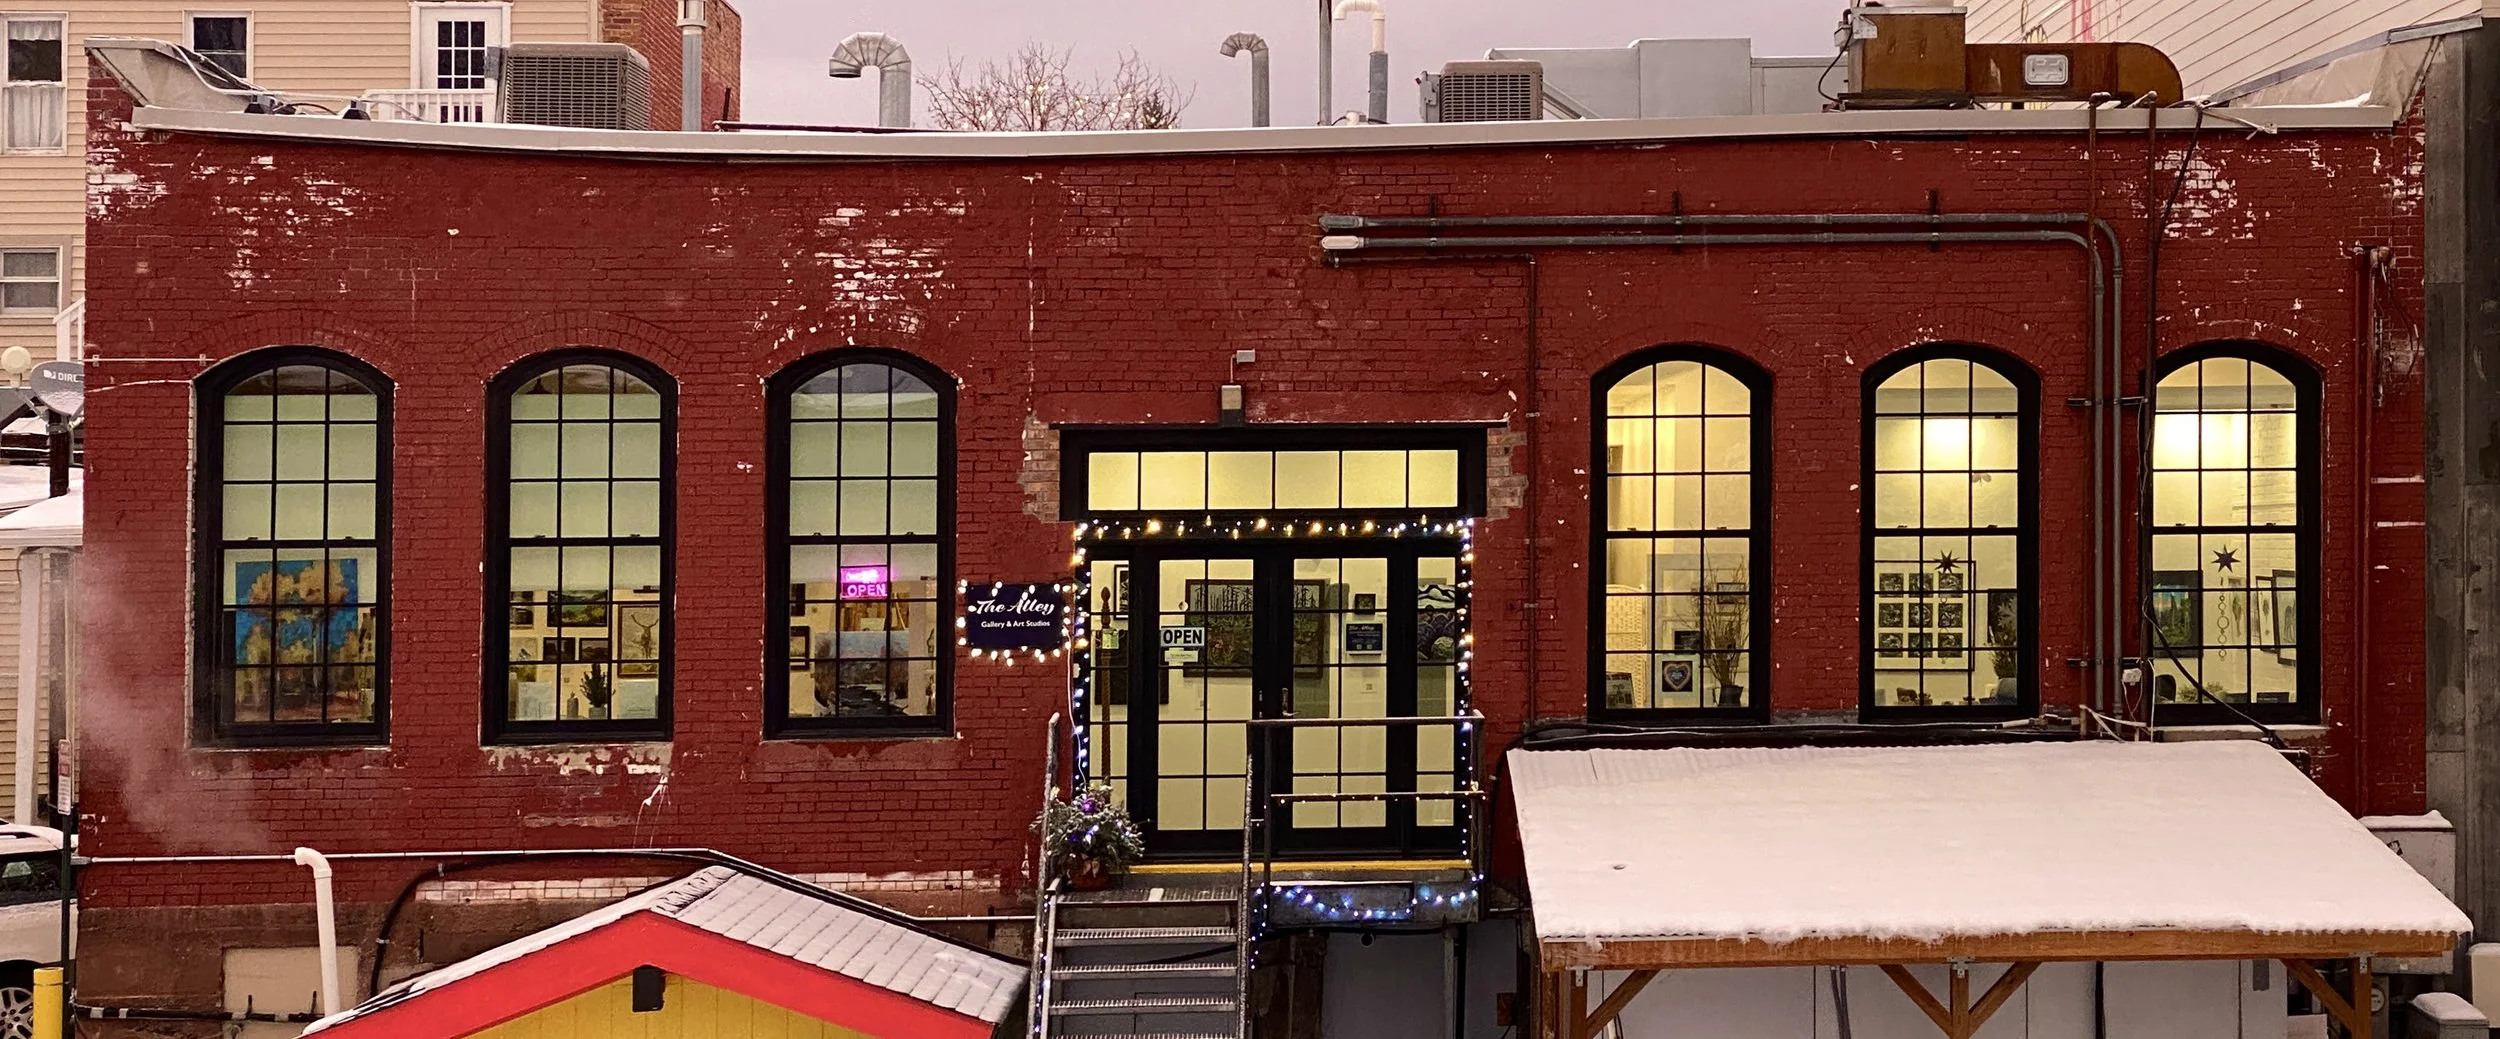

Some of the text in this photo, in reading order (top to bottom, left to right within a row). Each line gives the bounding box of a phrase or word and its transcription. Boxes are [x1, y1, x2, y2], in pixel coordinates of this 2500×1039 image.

[847, 584, 887, 597] OPEN
[976, 598, 1055, 616] The Alley
[981, 621, 1005, 629] Gallery
[1163, 629, 1203, 644] OPEN
